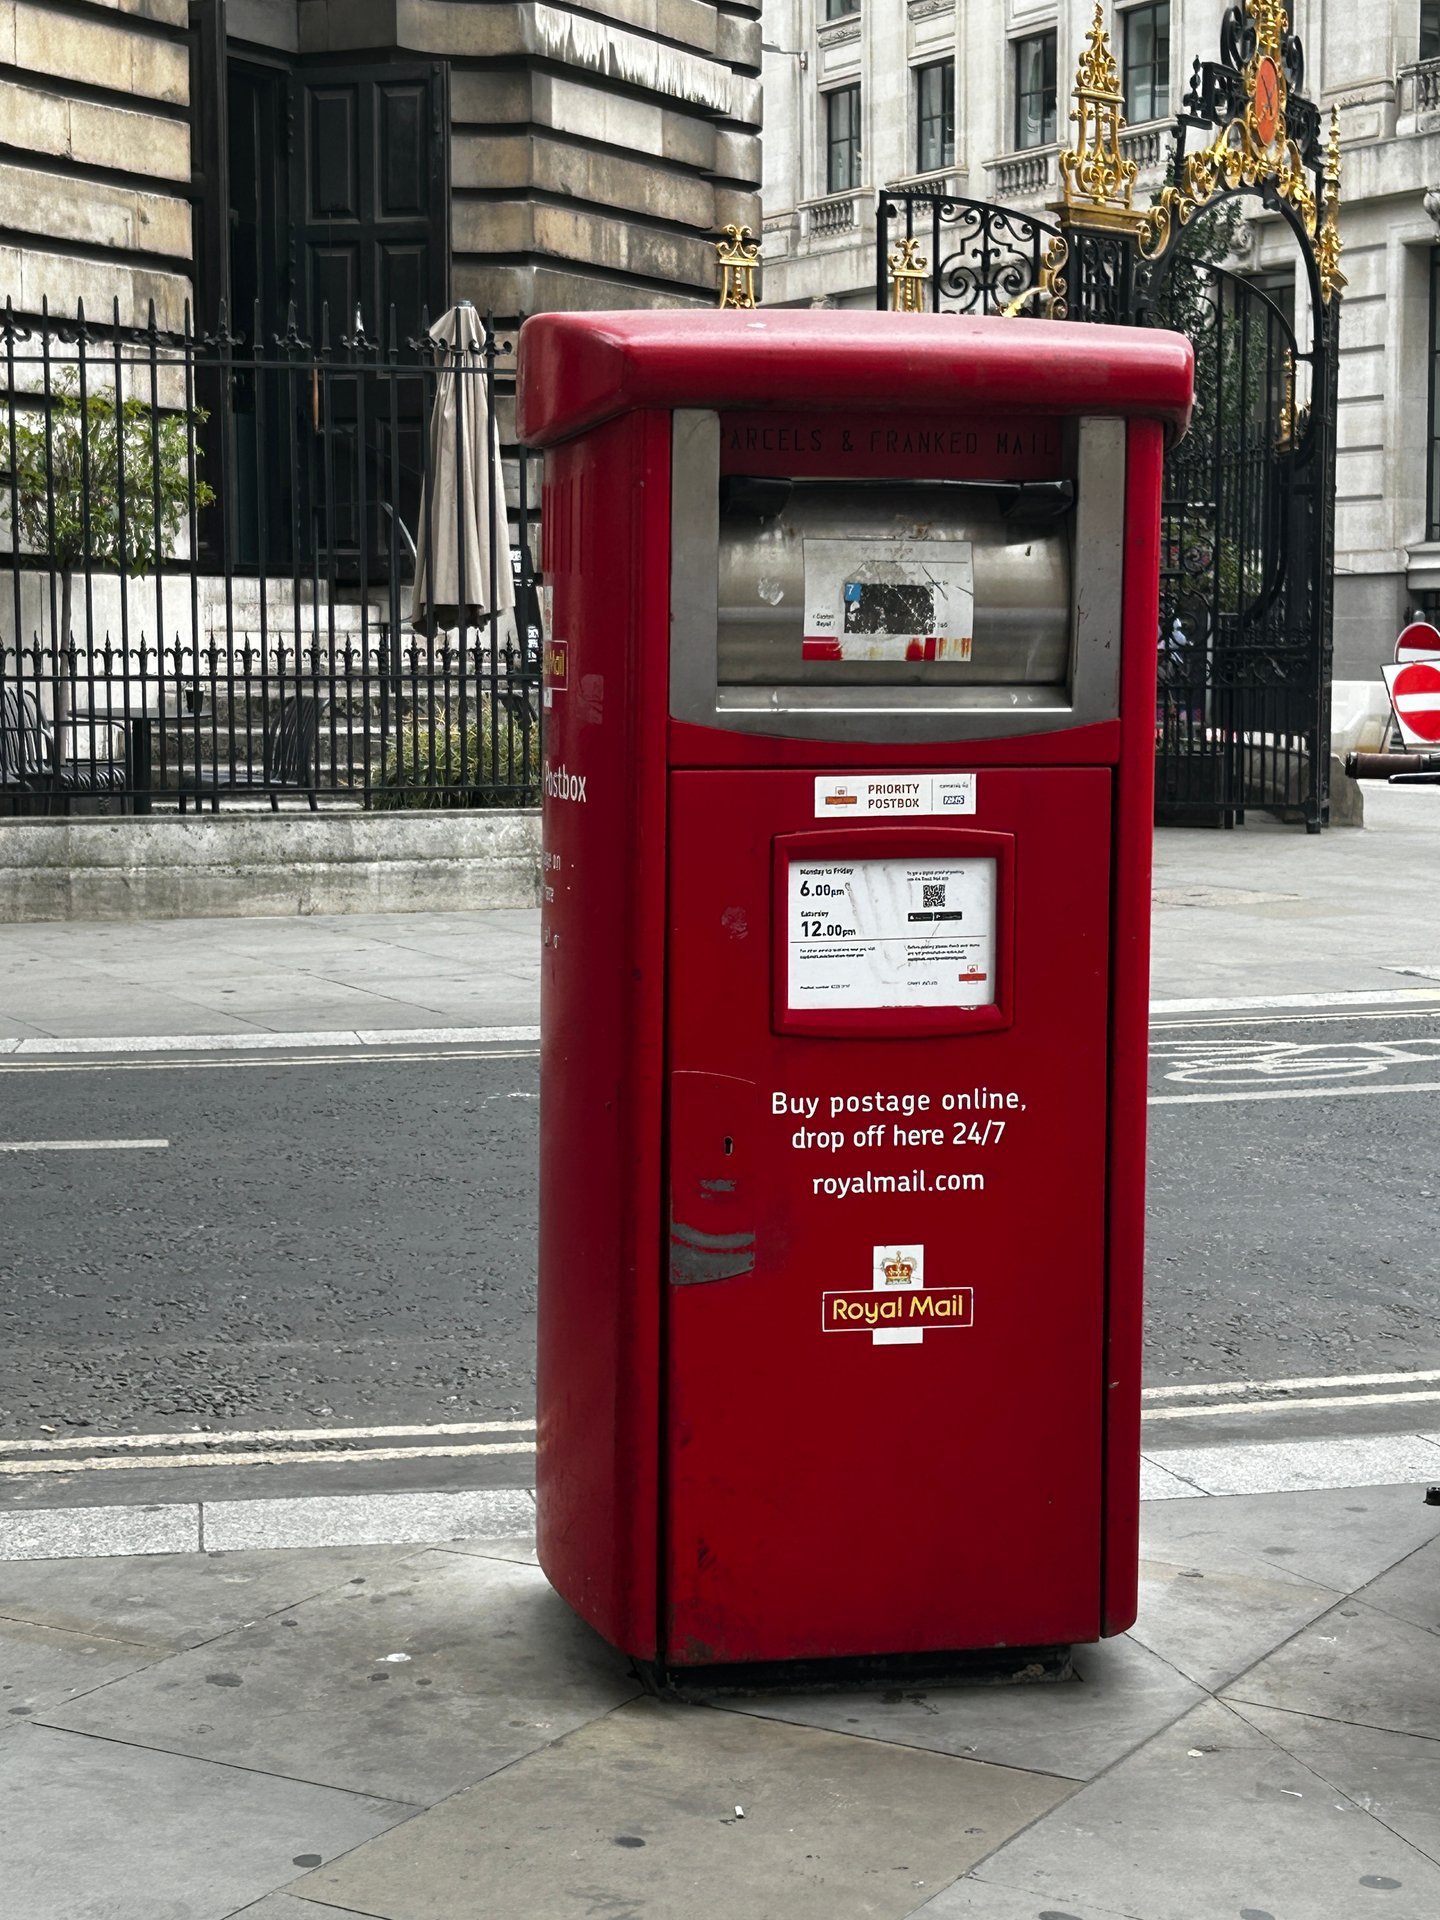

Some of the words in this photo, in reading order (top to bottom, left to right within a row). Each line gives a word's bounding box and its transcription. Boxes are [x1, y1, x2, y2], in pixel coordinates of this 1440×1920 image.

[842, 433, 854, 452] &
[869, 429, 978, 454] FRANKED
[996, 432, 1054, 456] MAIL
[544, 759, 587, 803] Postbox
[867, 783, 920, 795] PRIORITY
[867, 798, 920, 809] POSTBOX
[799, 868, 825, 876] Monday
[833, 867, 854, 876] Friday
[799, 880, 845, 897] 6.00pm
[801, 920, 856, 937] 12.00pm
[772, 1091, 820, 1118] Buy
[830, 1091, 930, 1118] postage
[942, 1087, 1027, 1111] online,
[791, 1126, 845, 1153] drop
[853, 1125, 886, 1148] off
[893, 1124, 944, 1146] here
[952, 1120, 1006, 1146] 24/7
[812, 1169, 985, 1199] royalmail.com
[832, 1295, 903, 1324] Royal
[909, 1294, 963, 1318] Mail
